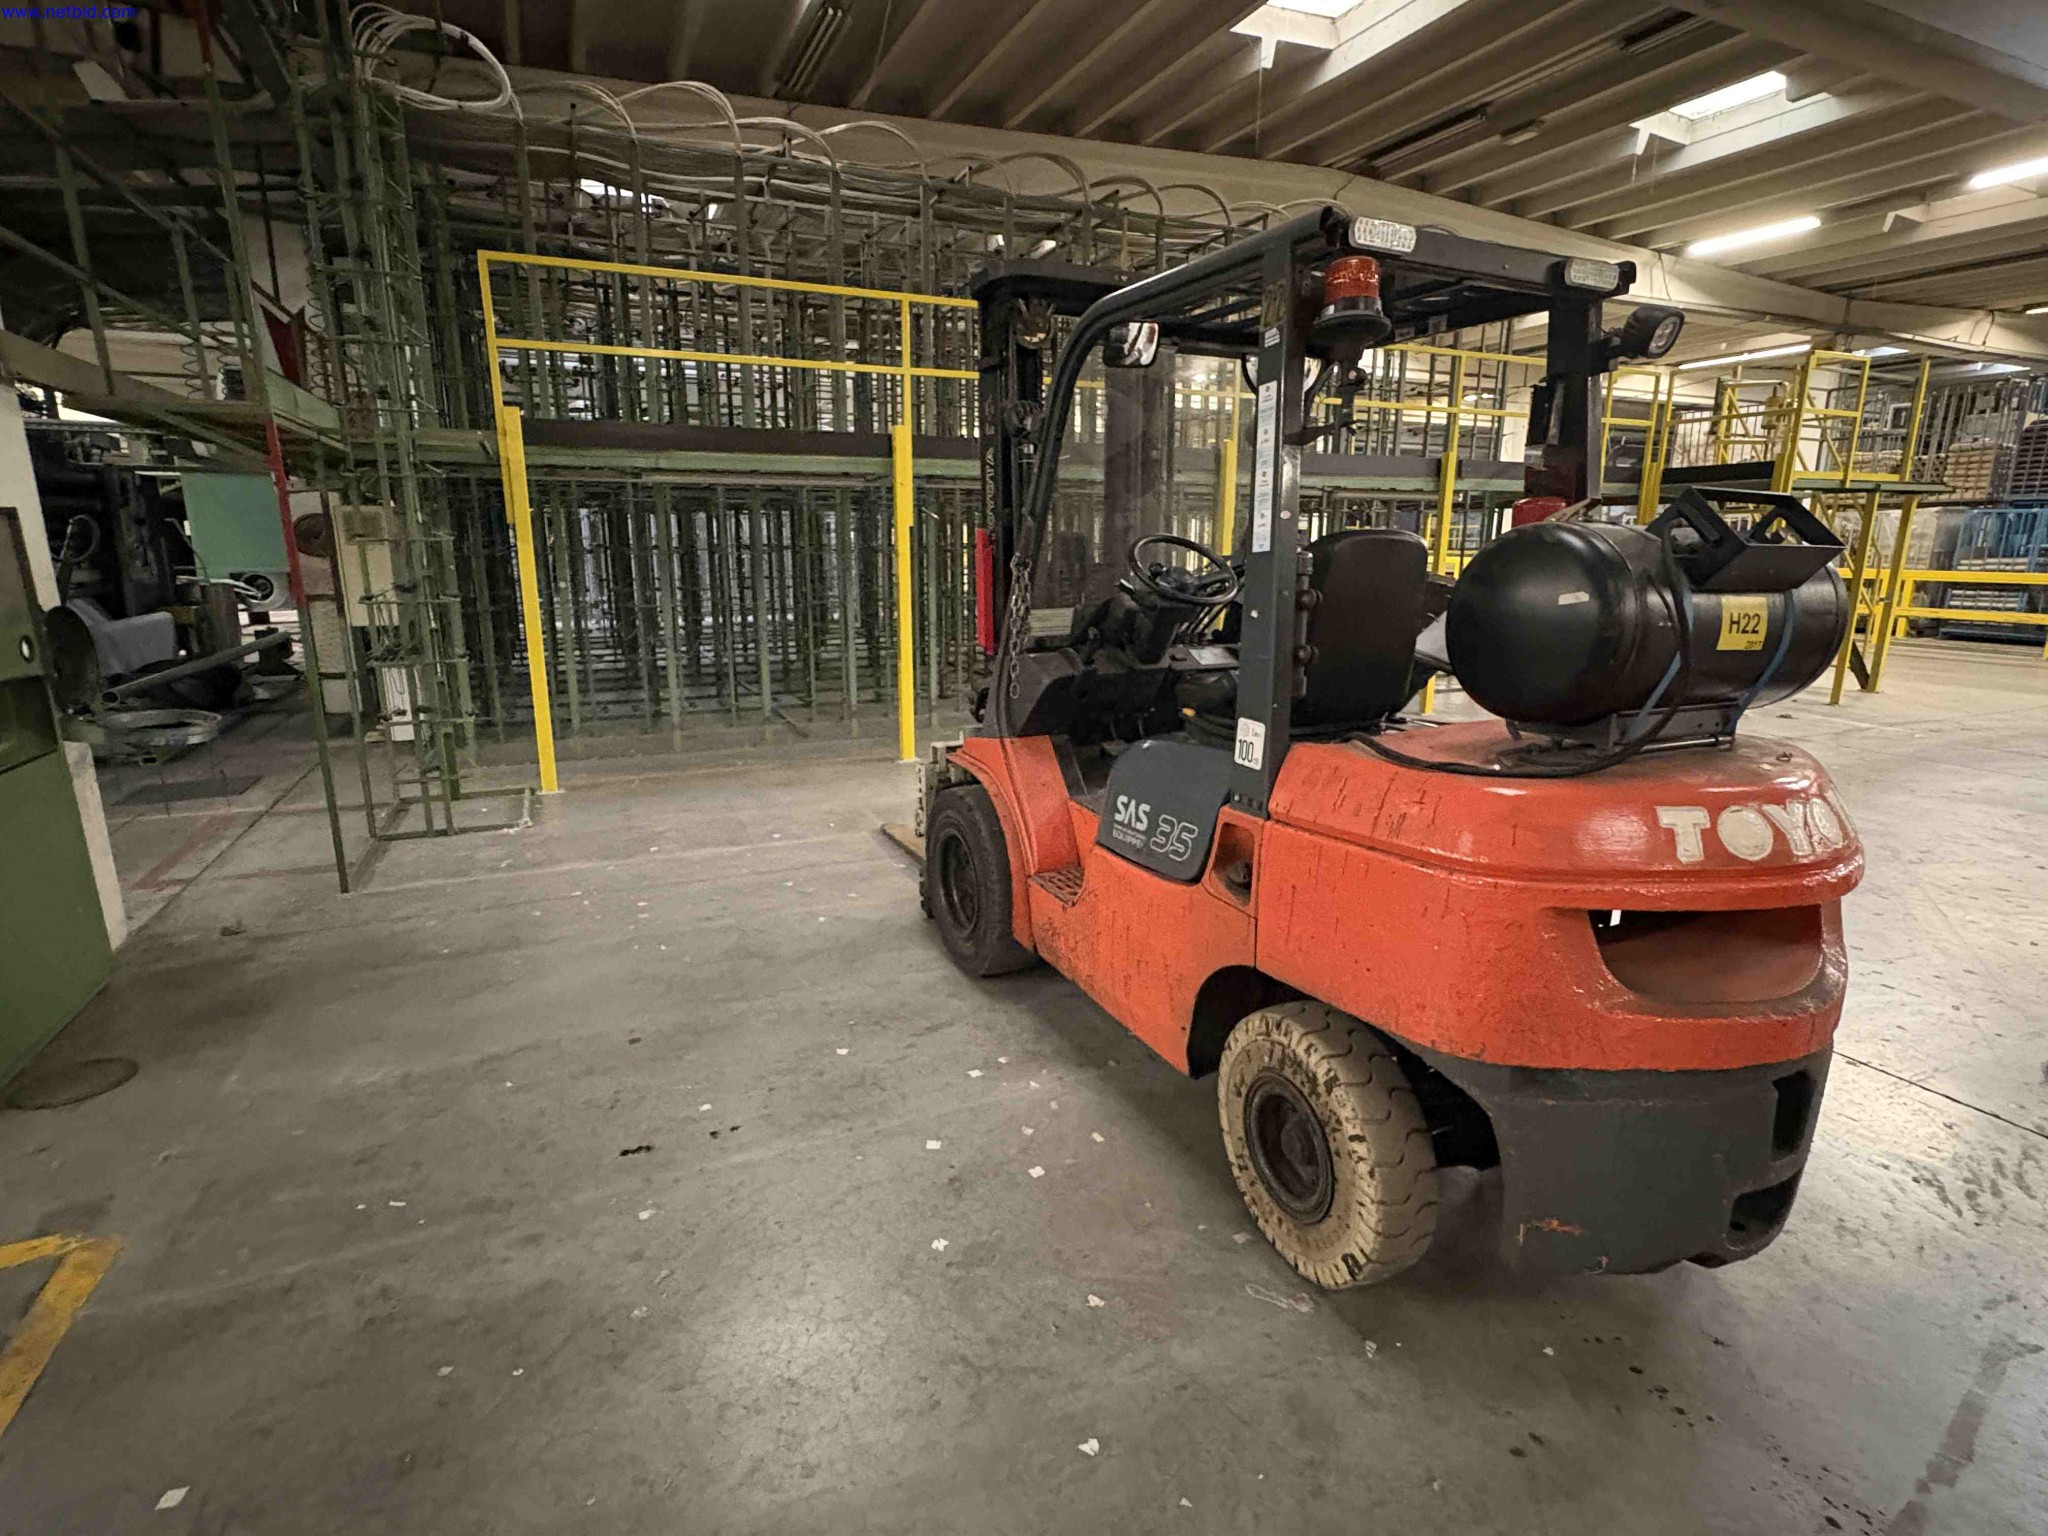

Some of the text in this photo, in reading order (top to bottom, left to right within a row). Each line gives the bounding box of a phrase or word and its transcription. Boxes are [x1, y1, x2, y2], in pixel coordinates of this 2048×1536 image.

[1728, 612, 1761, 634] H22
[1238, 738, 1255, 763] 100
[1114, 795, 1151, 831] SAS
[1150, 814, 1199, 862] 35
